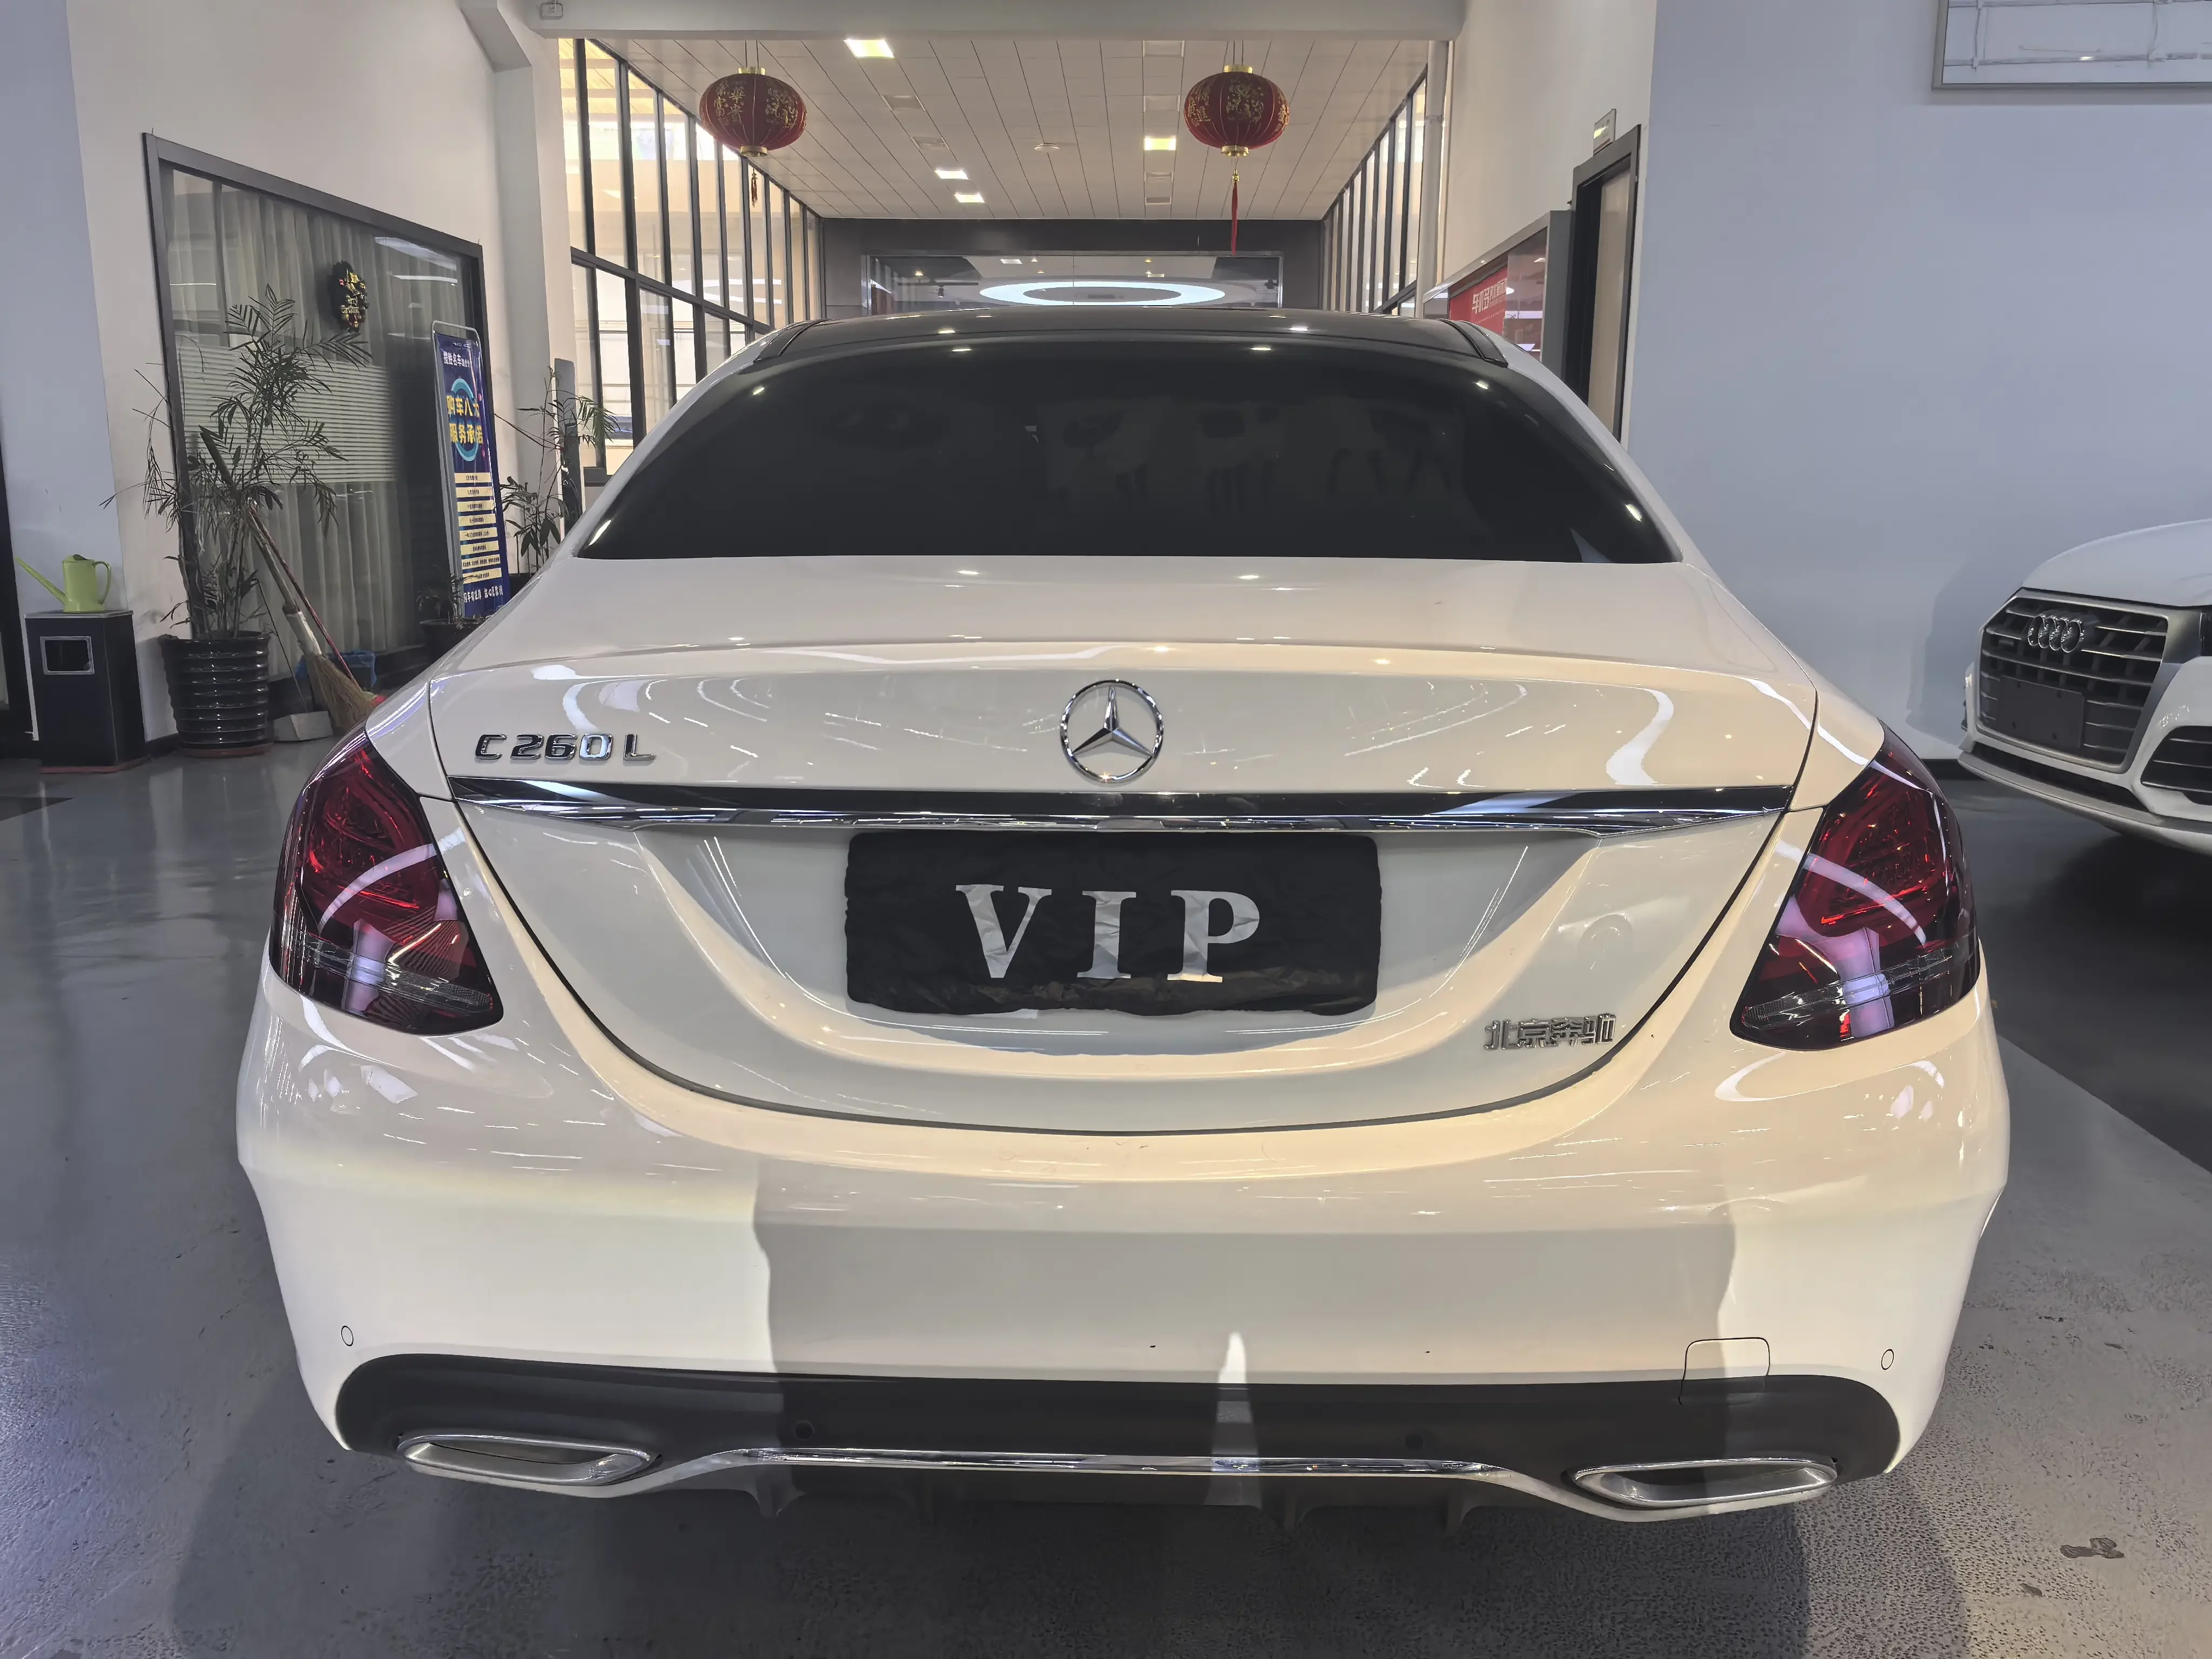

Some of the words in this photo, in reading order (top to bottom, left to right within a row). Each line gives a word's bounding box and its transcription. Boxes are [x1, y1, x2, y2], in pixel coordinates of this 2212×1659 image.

[446, 395, 480, 417] 购车八大
[449, 423, 483, 444] 服务承诺
[475, 733, 507, 761] C
[510, 733, 614, 761] 260
[623, 733, 657, 762] L
[955, 884, 1260, 983] VIP
[1484, 1013, 1616, 1050] 北京奔驰
